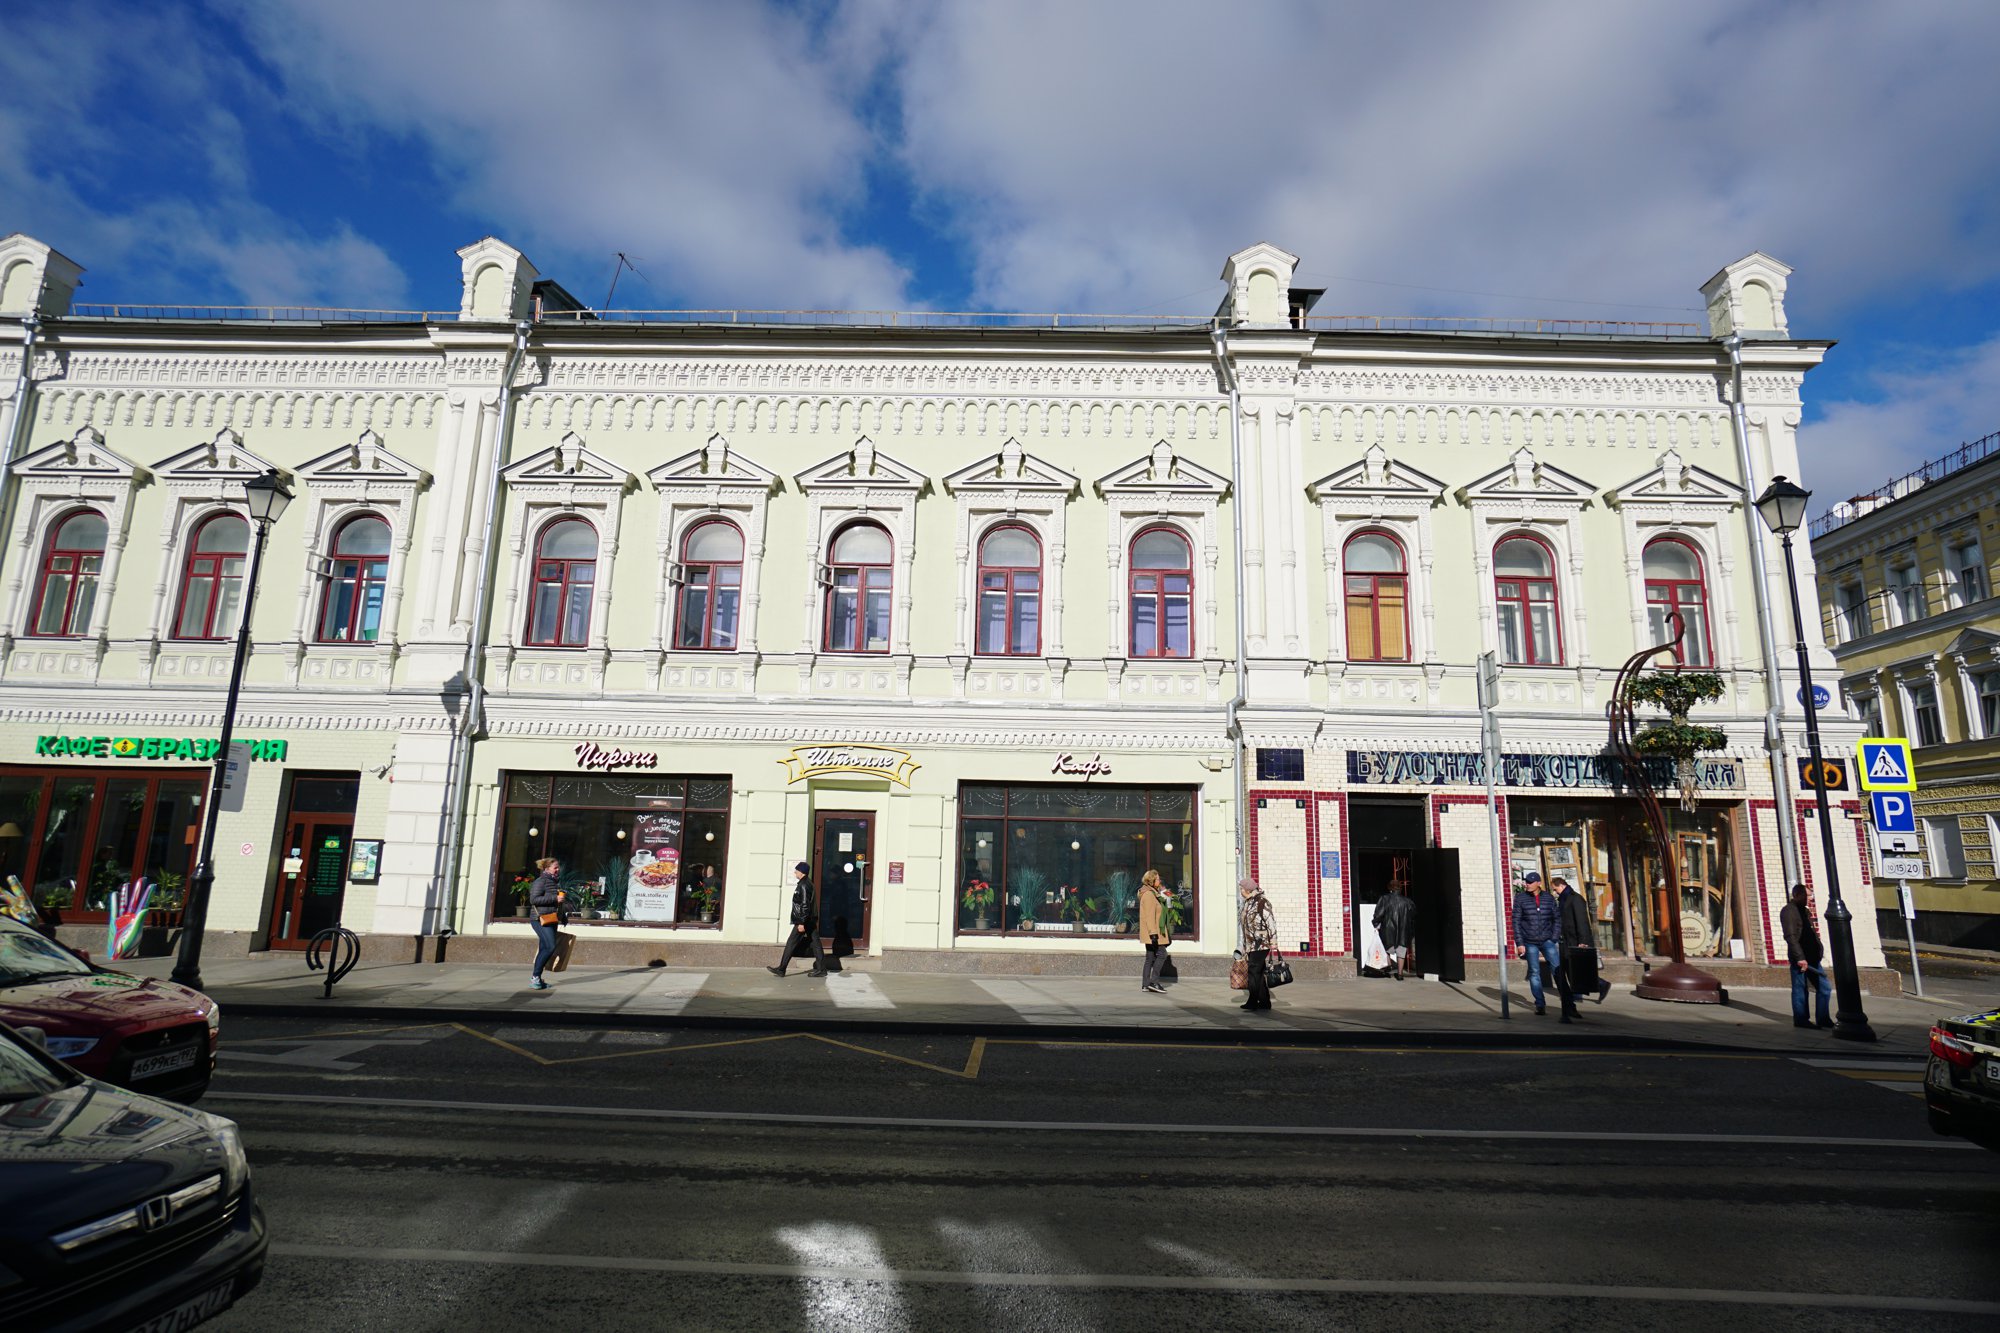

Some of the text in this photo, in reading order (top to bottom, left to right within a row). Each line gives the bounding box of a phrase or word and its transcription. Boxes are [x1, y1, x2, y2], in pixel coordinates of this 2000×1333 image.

[36, 736, 110, 758] КАФЕ
[142, 738, 288, 762] БРАЗИИЯ
[573, 741, 658, 772] Пироги
[807, 747, 894, 768] Штолле
[1051, 752, 1112, 783] Кафе
[1895, 863, 1904, 872] 15
[1906, 863, 1919, 873] 20
